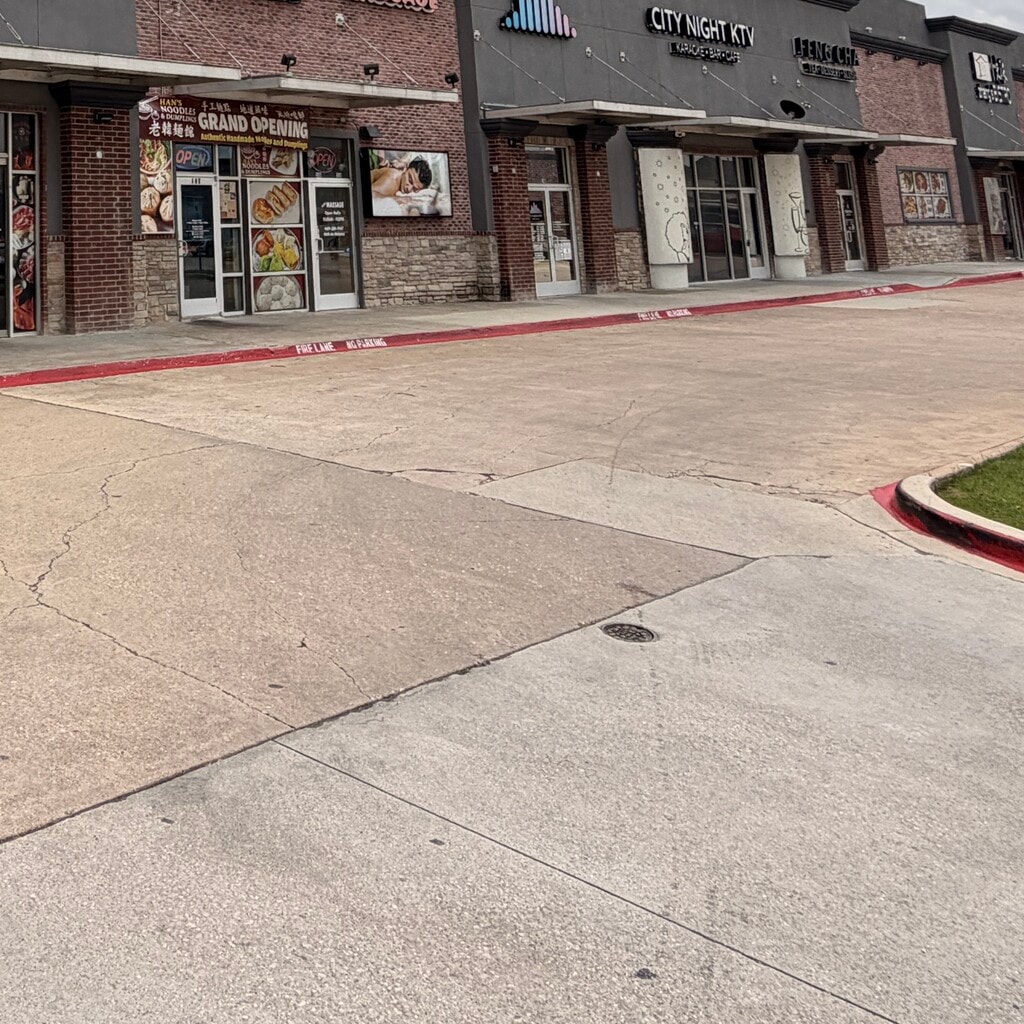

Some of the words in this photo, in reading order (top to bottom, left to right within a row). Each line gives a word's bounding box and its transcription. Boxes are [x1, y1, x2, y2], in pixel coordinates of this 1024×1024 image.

[650, 6, 682, 34] CITY
[685, 14, 727, 42] NIGHT
[730, 22, 755, 48] KTV
[160, 105, 196, 117] NOODLES
[166, 113, 197, 124] DUMPLINGS
[198, 112, 249, 133] GRAND
[250, 115, 309, 140] OPENING
[175, 149, 207, 168] OPEN
[313, 150, 335, 168] OPEN
[296, 343, 315, 355] FIRE
[315, 341, 336, 353] LANE
[345, 340, 358, 350] NO
[358, 337, 388, 349] PARKING
